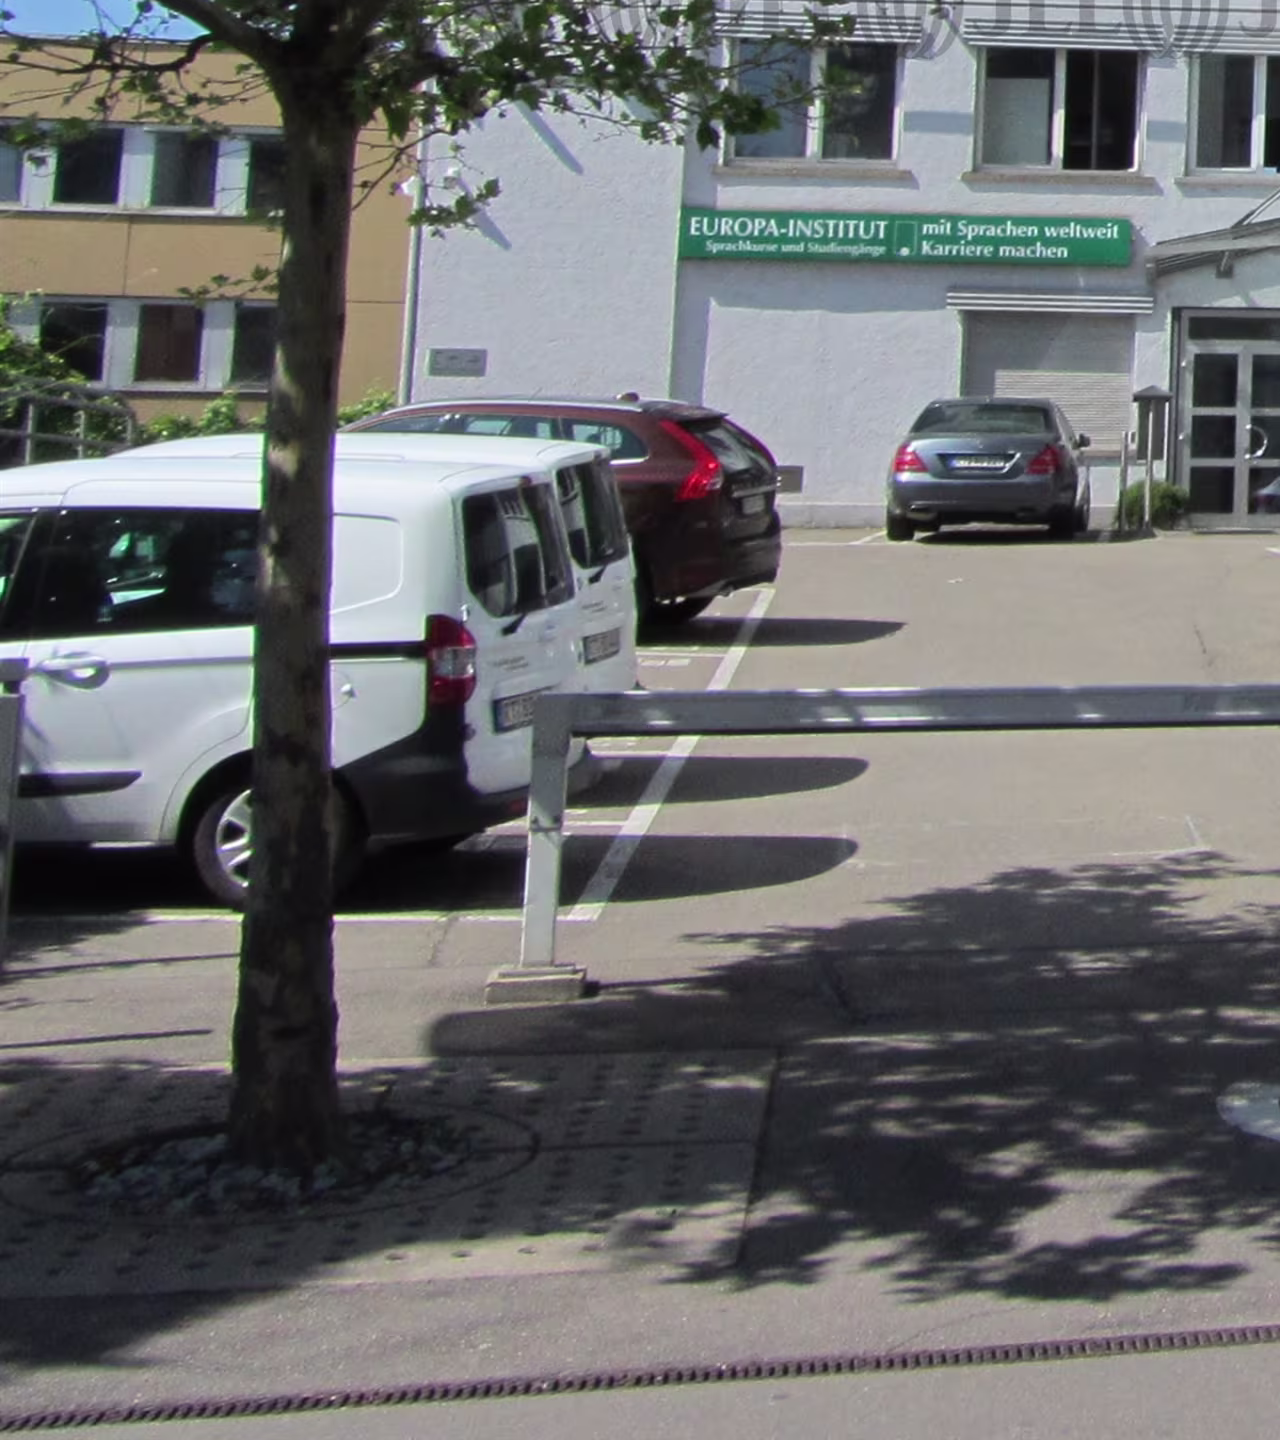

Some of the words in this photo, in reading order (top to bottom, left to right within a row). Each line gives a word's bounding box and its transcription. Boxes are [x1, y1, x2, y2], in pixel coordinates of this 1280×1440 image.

[689, 216, 889, 240] EUROPA-INSTITUT
[921, 219, 952, 236] mit
[957, 220, 1038, 241] Sprachen
[1044, 222, 1119, 239] weltweit
[705, 239, 778, 254] Sprachkurse
[781, 241, 805, 253] und
[807, 241, 887, 257] Studiengänge
[921, 240, 993, 257] Karriere
[999, 242, 1068, 258] machen
